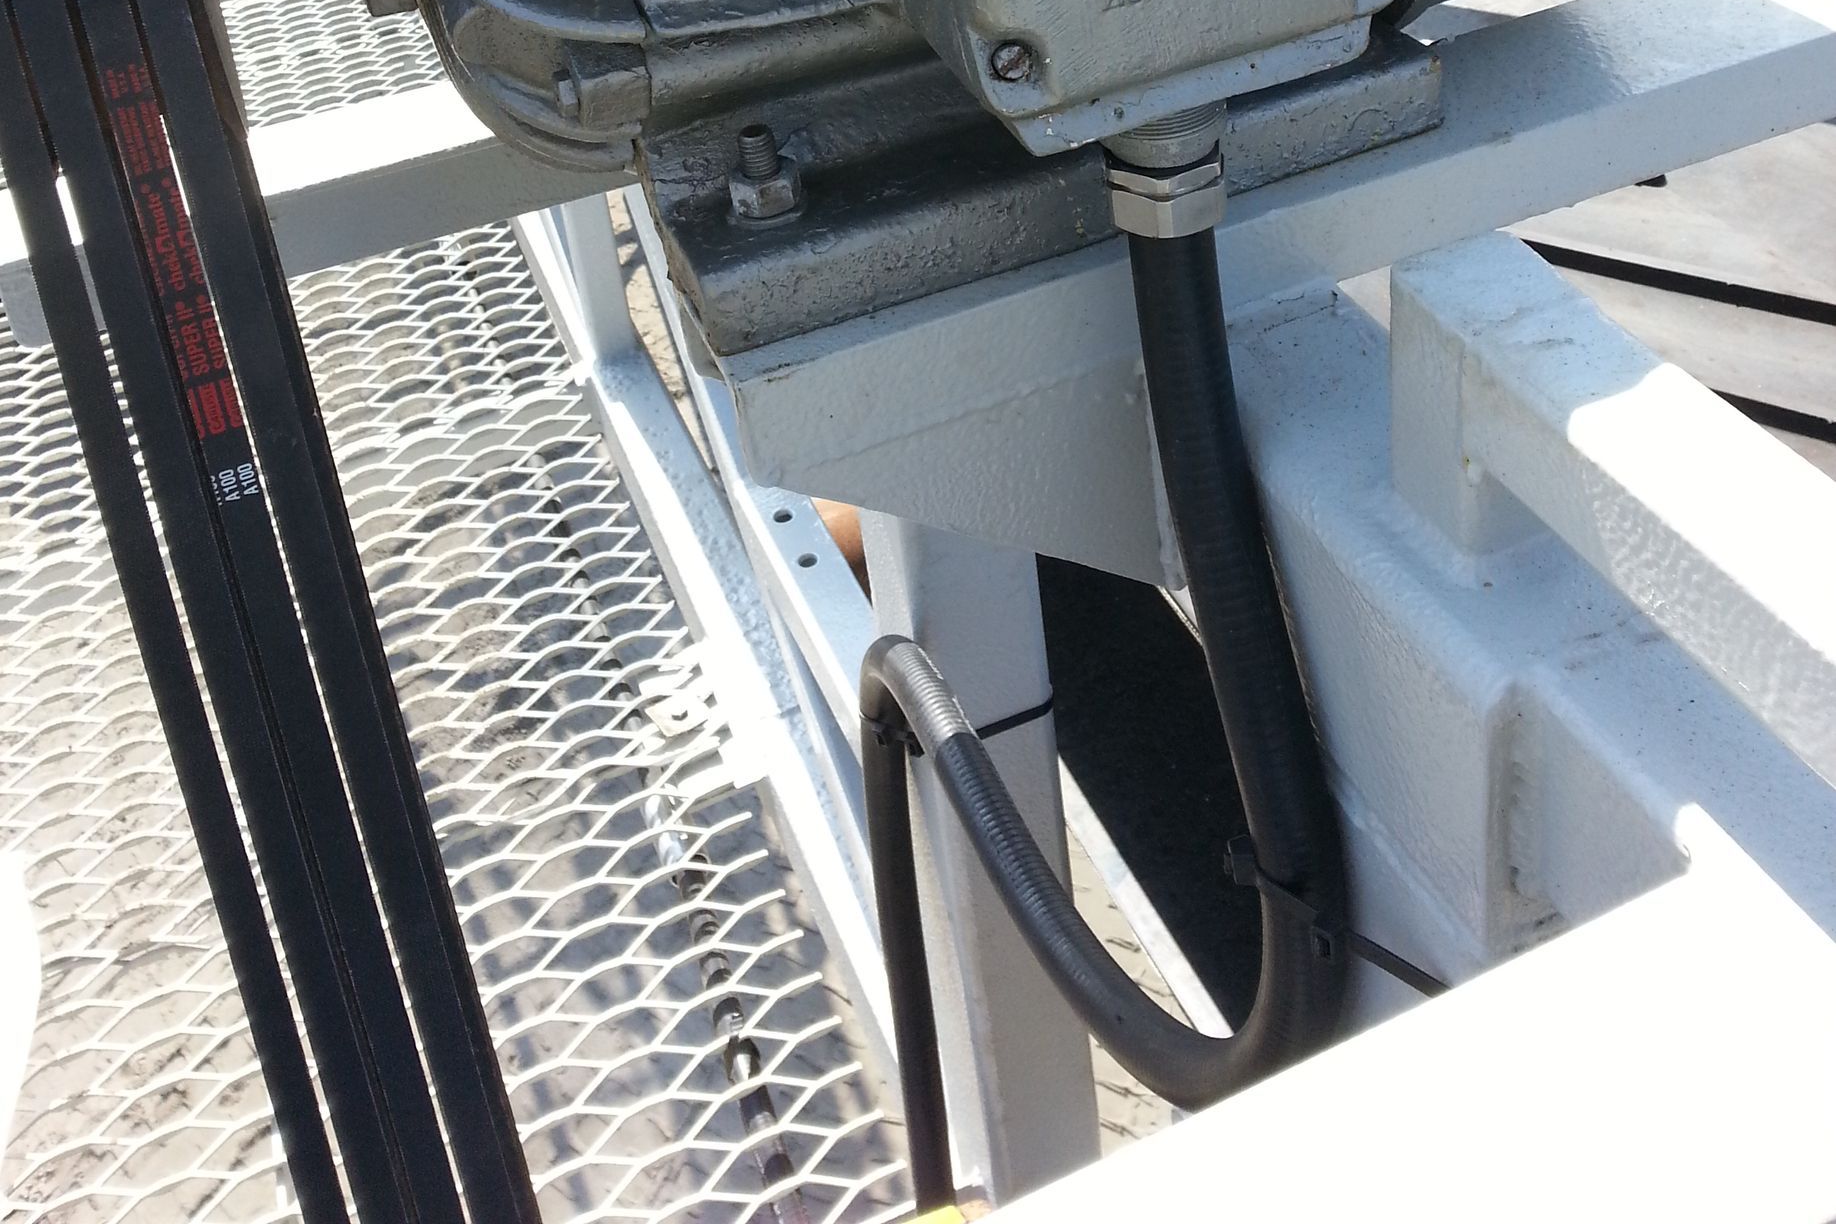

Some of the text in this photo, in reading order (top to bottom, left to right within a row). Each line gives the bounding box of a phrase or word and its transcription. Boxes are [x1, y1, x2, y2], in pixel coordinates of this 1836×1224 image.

[180, 321, 211, 377] SUPER
[202, 316, 228, 369] SUPER
[217, 467, 241, 503] A100
[236, 461, 259, 496] A100
